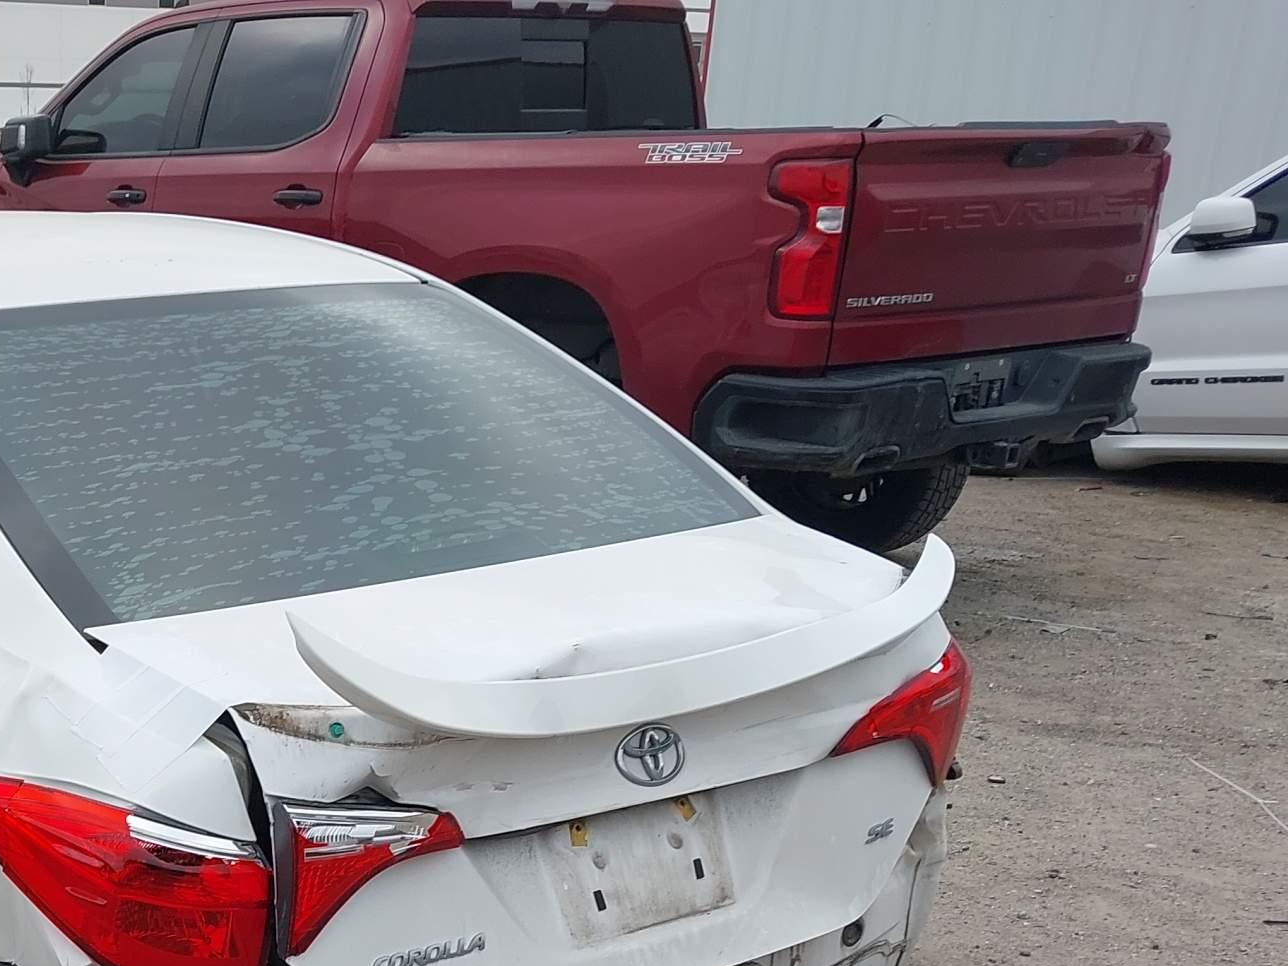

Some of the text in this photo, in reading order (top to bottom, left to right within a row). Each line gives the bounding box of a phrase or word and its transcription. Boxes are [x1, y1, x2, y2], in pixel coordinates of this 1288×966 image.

[638, 141, 743, 156] TRAIL
[645, 154, 728, 164] BOSS
[884, 198, 1151, 233] CHEVROLET
[845, 292, 934, 308] SILVERADO
[865, 817, 894, 845] SE
